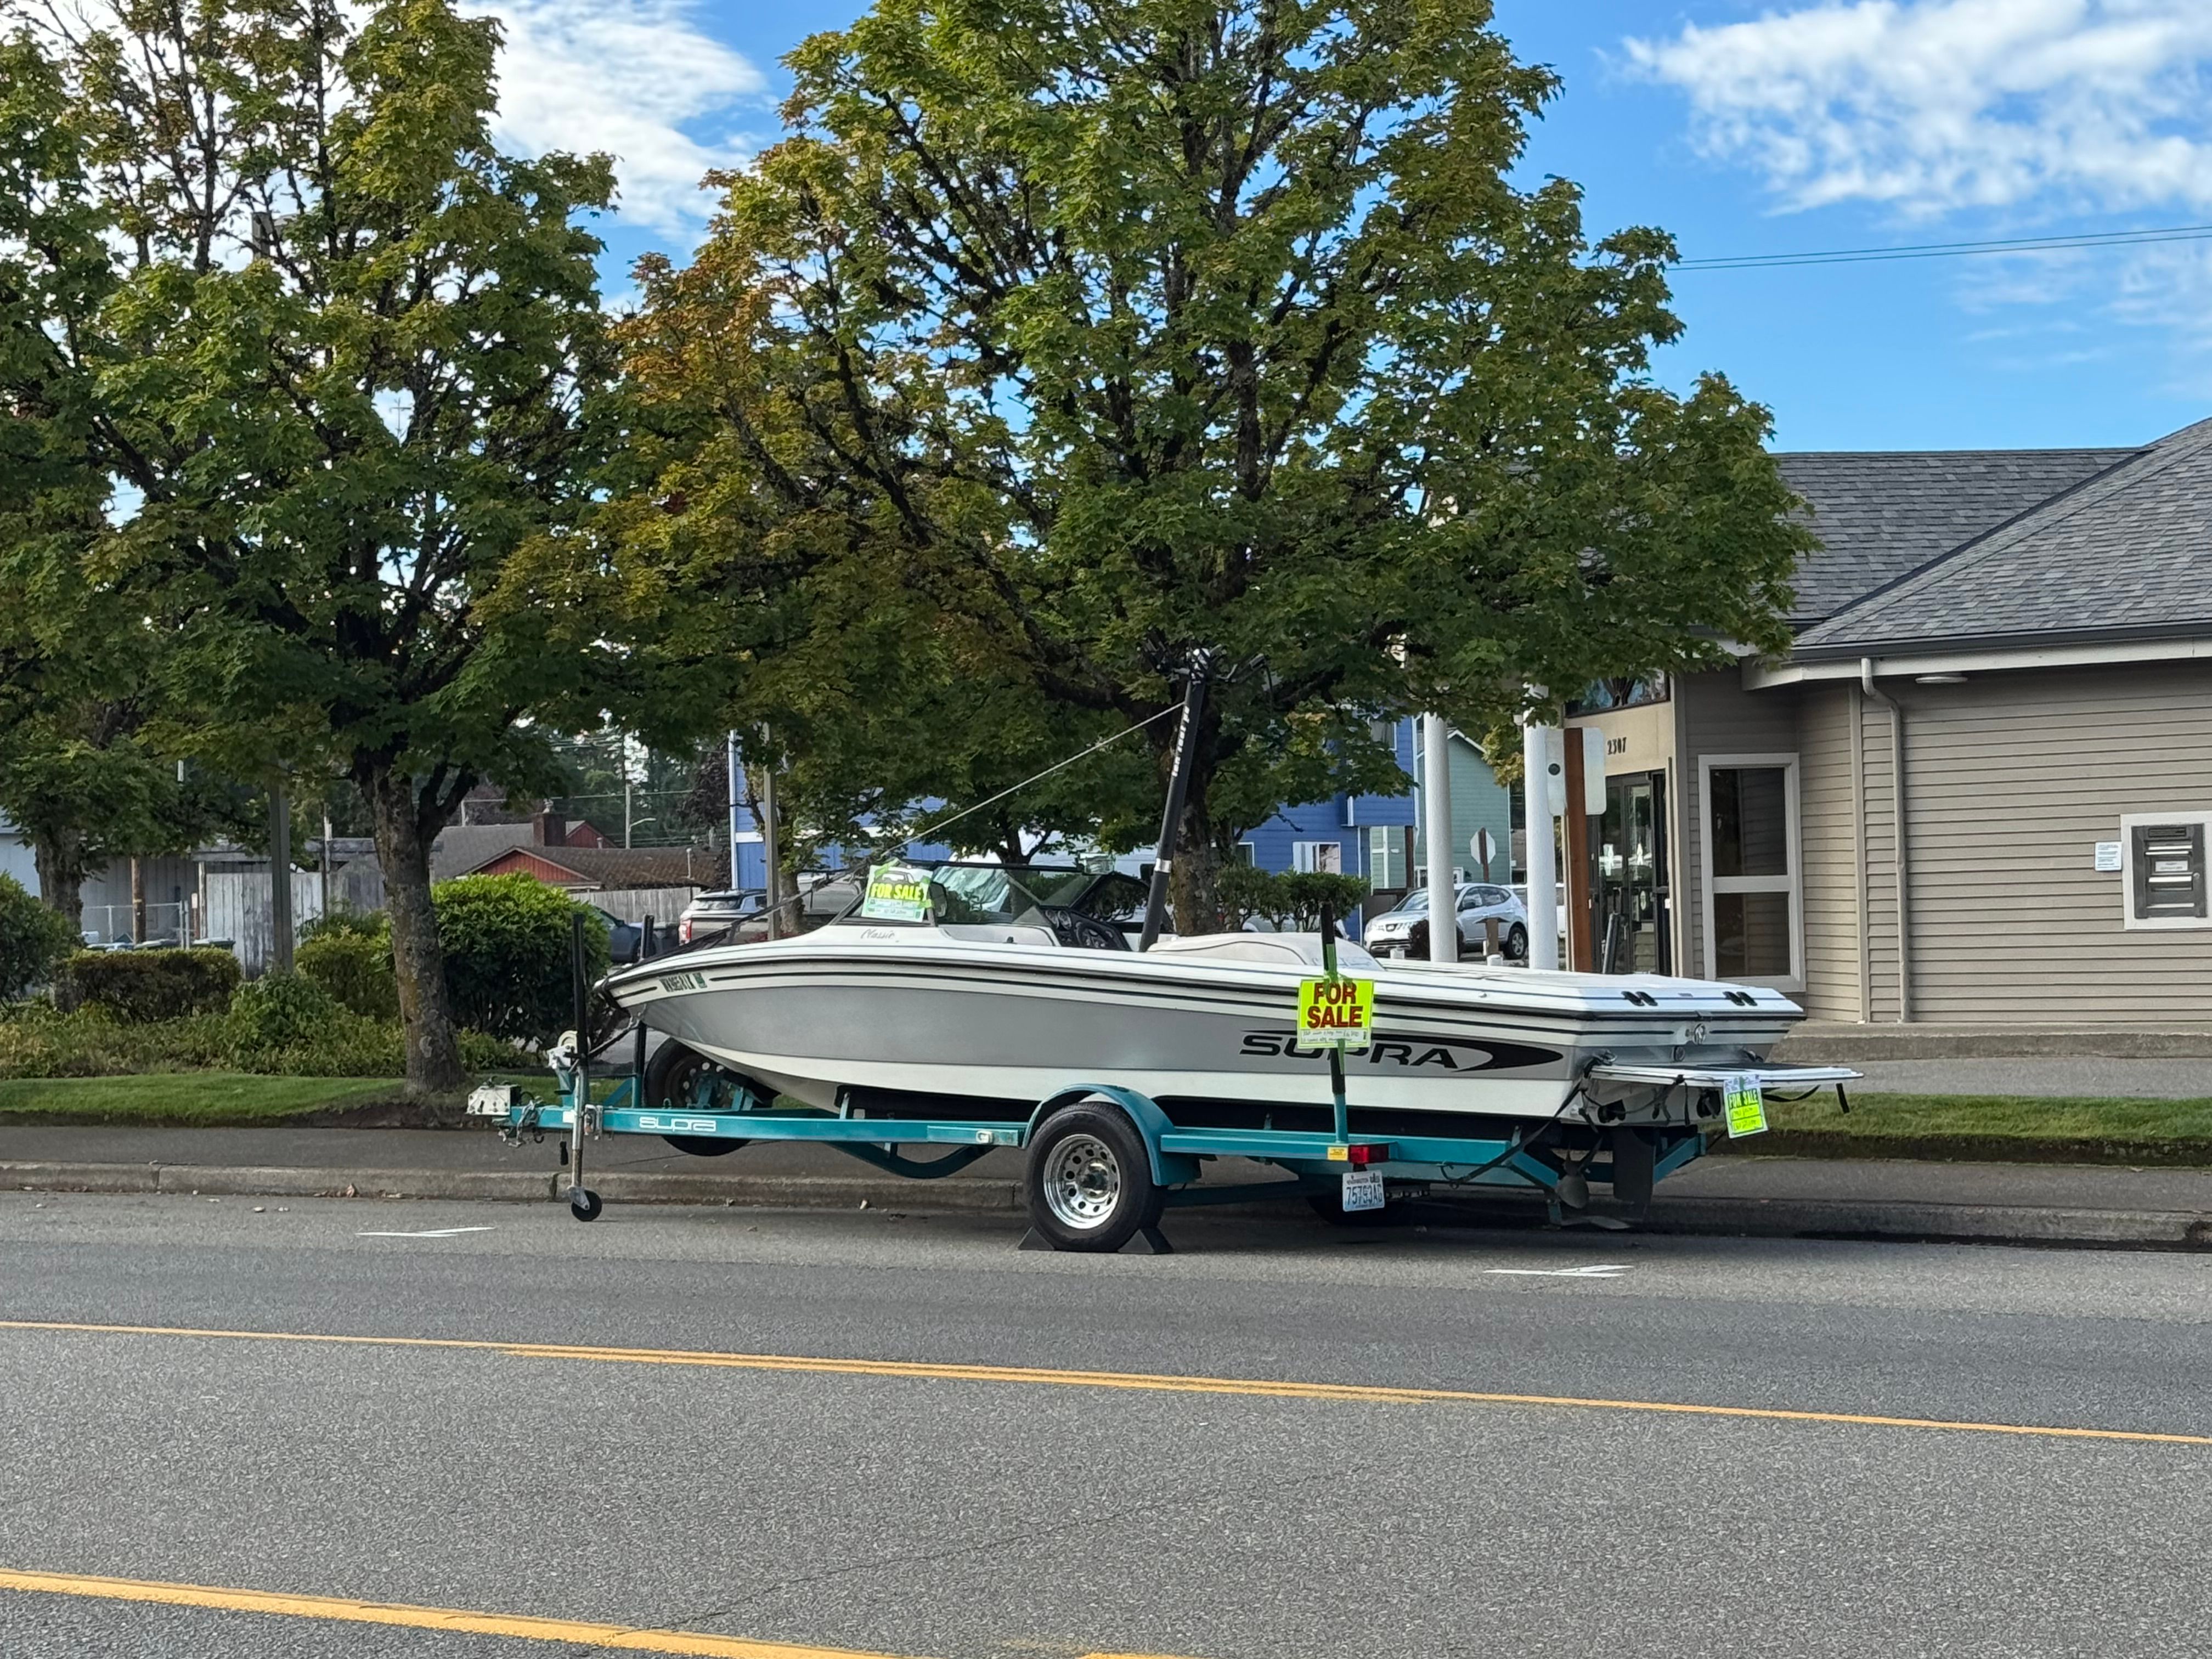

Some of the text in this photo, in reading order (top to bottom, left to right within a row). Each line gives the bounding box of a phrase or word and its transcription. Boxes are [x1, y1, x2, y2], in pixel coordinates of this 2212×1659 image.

[1607, 737, 1627, 755] 2307
[870, 882, 922, 901] FOR SALE
[1313, 982, 1357, 1005] FOR
[1307, 1006, 1363, 1029] SALE
[1728, 1089, 1758, 1109] FOR SALE
